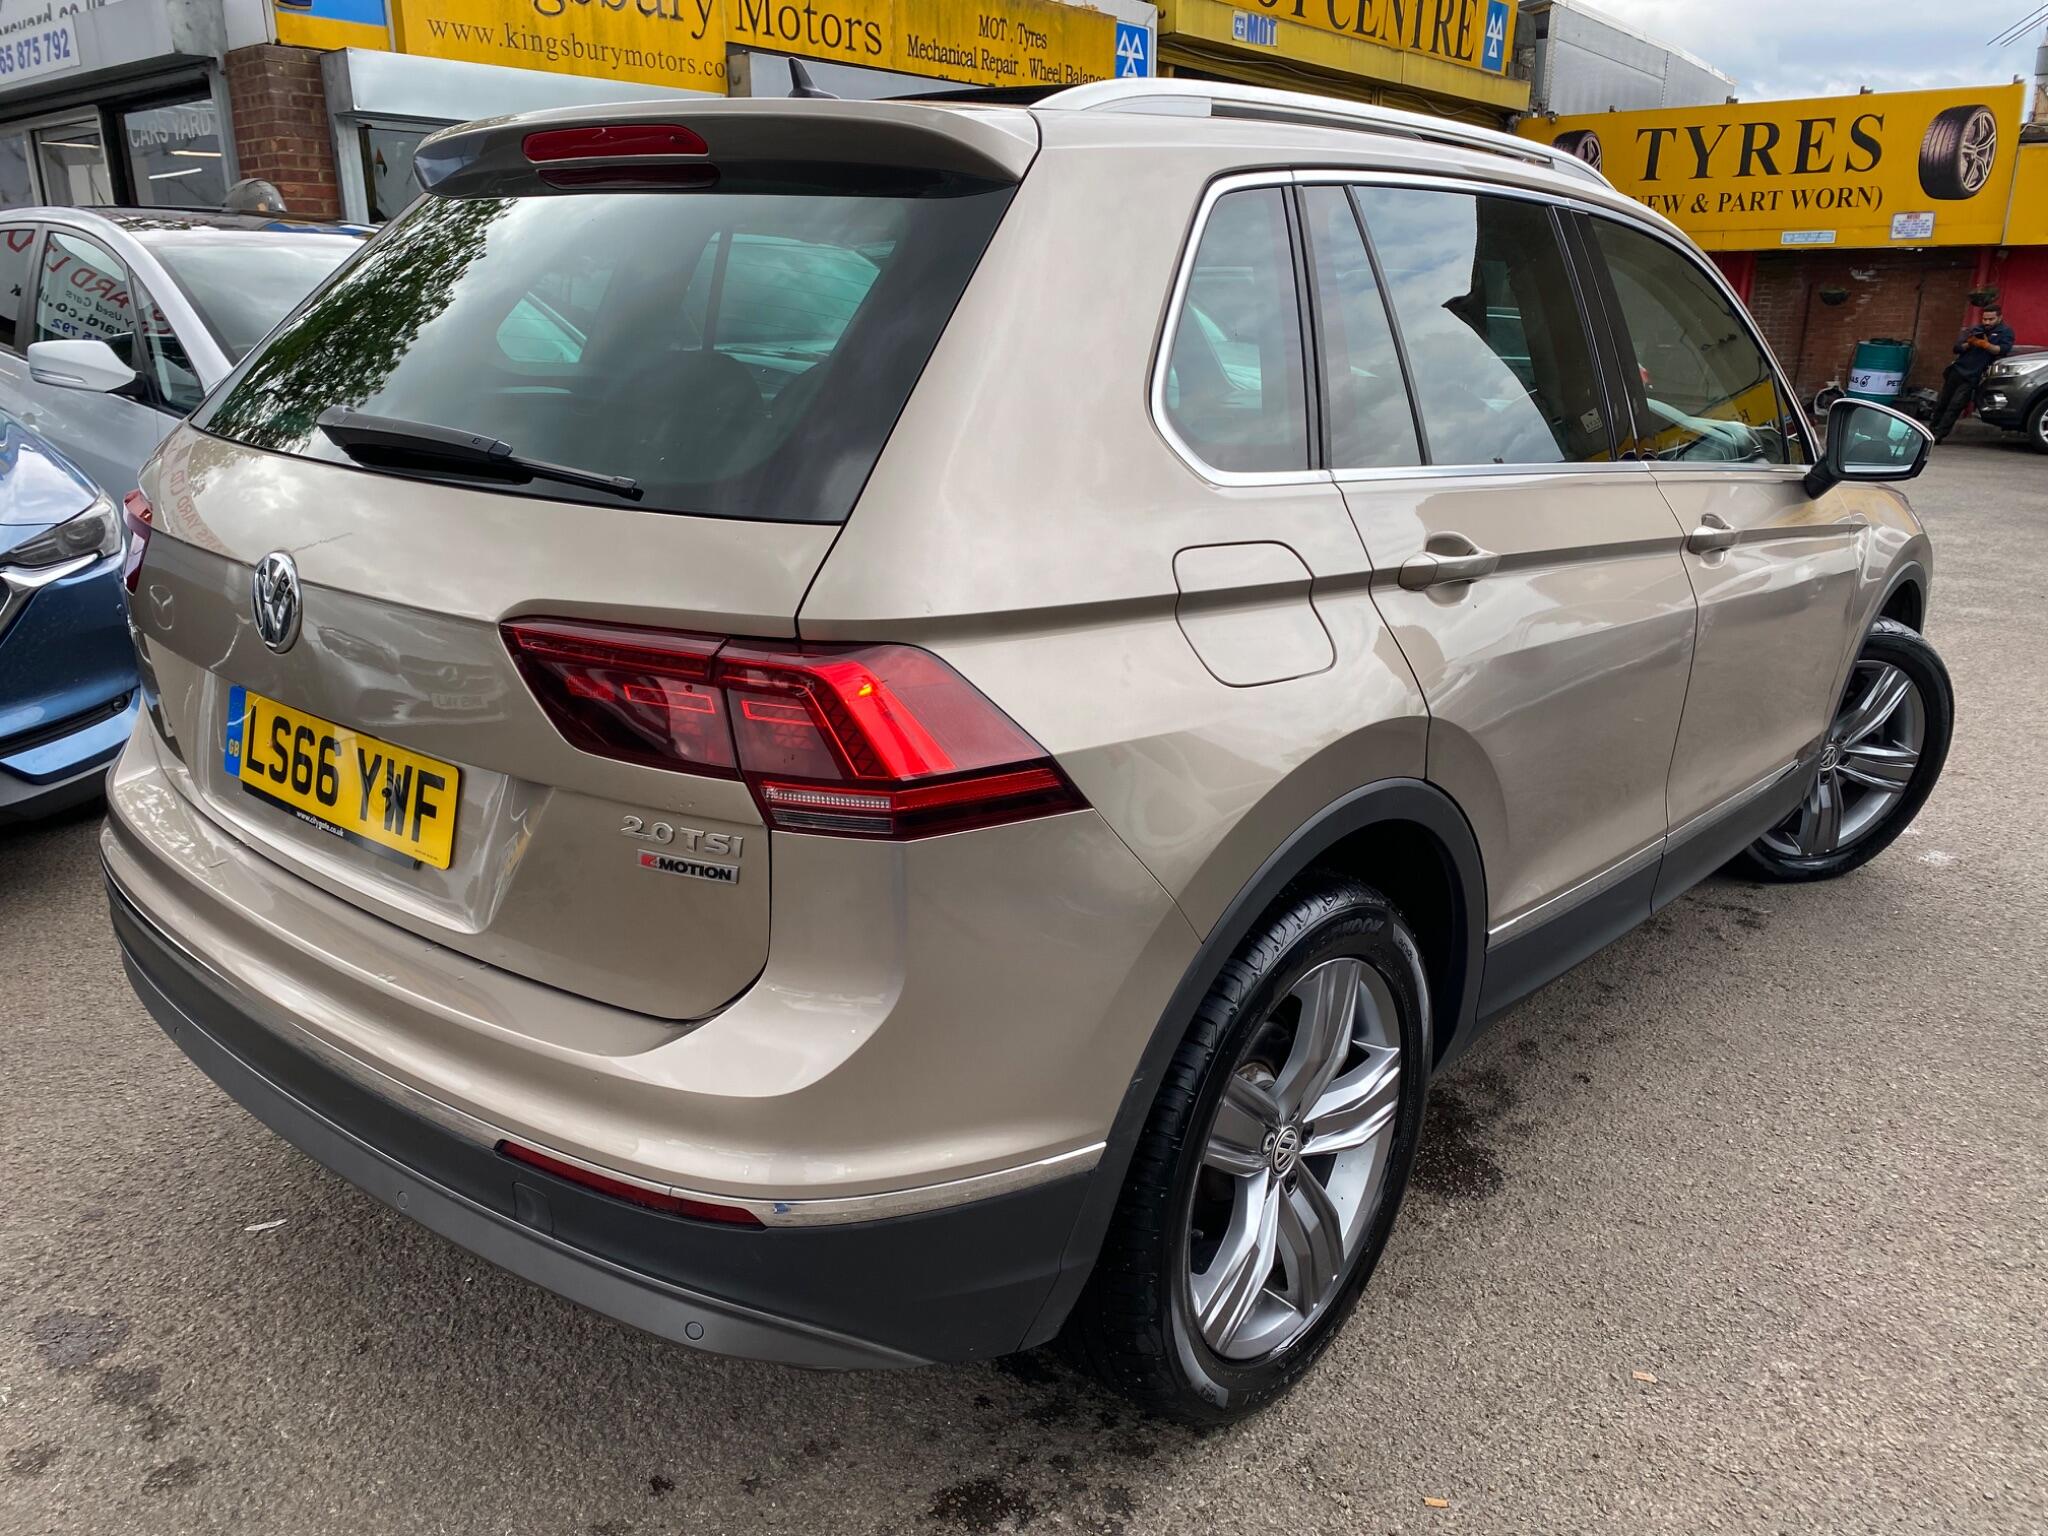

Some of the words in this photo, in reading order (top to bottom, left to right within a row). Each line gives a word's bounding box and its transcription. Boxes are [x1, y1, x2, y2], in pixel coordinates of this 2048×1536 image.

[735, 0, 882, 55] Motors
[979, 15, 1007, 41] MOT
[1017, 23, 1047, 50] Tyres
[1247, 14, 1277, 45] MOT
[17, 37, 41, 69] 875
[44, 28, 70, 62] 792
[907, 34, 977, 69] Mechanical
[981, 49, 1019, 78] Repair
[1030, 58, 1062, 83] Wheel
[130, 120, 168, 147] CARS
[173, 111, 211, 140] YARD
[1636, 113, 1885, 181] TYRES
[1691, 193, 1709, 214] &
[1718, 190, 1784, 212] PART
[1791, 186, 1883, 212] WORN)
[228, 738, 240, 758] GB
[246, 704, 342, 808] LS66
[356, 746, 446, 843] YWF
[680, 826, 744, 859] TSI
